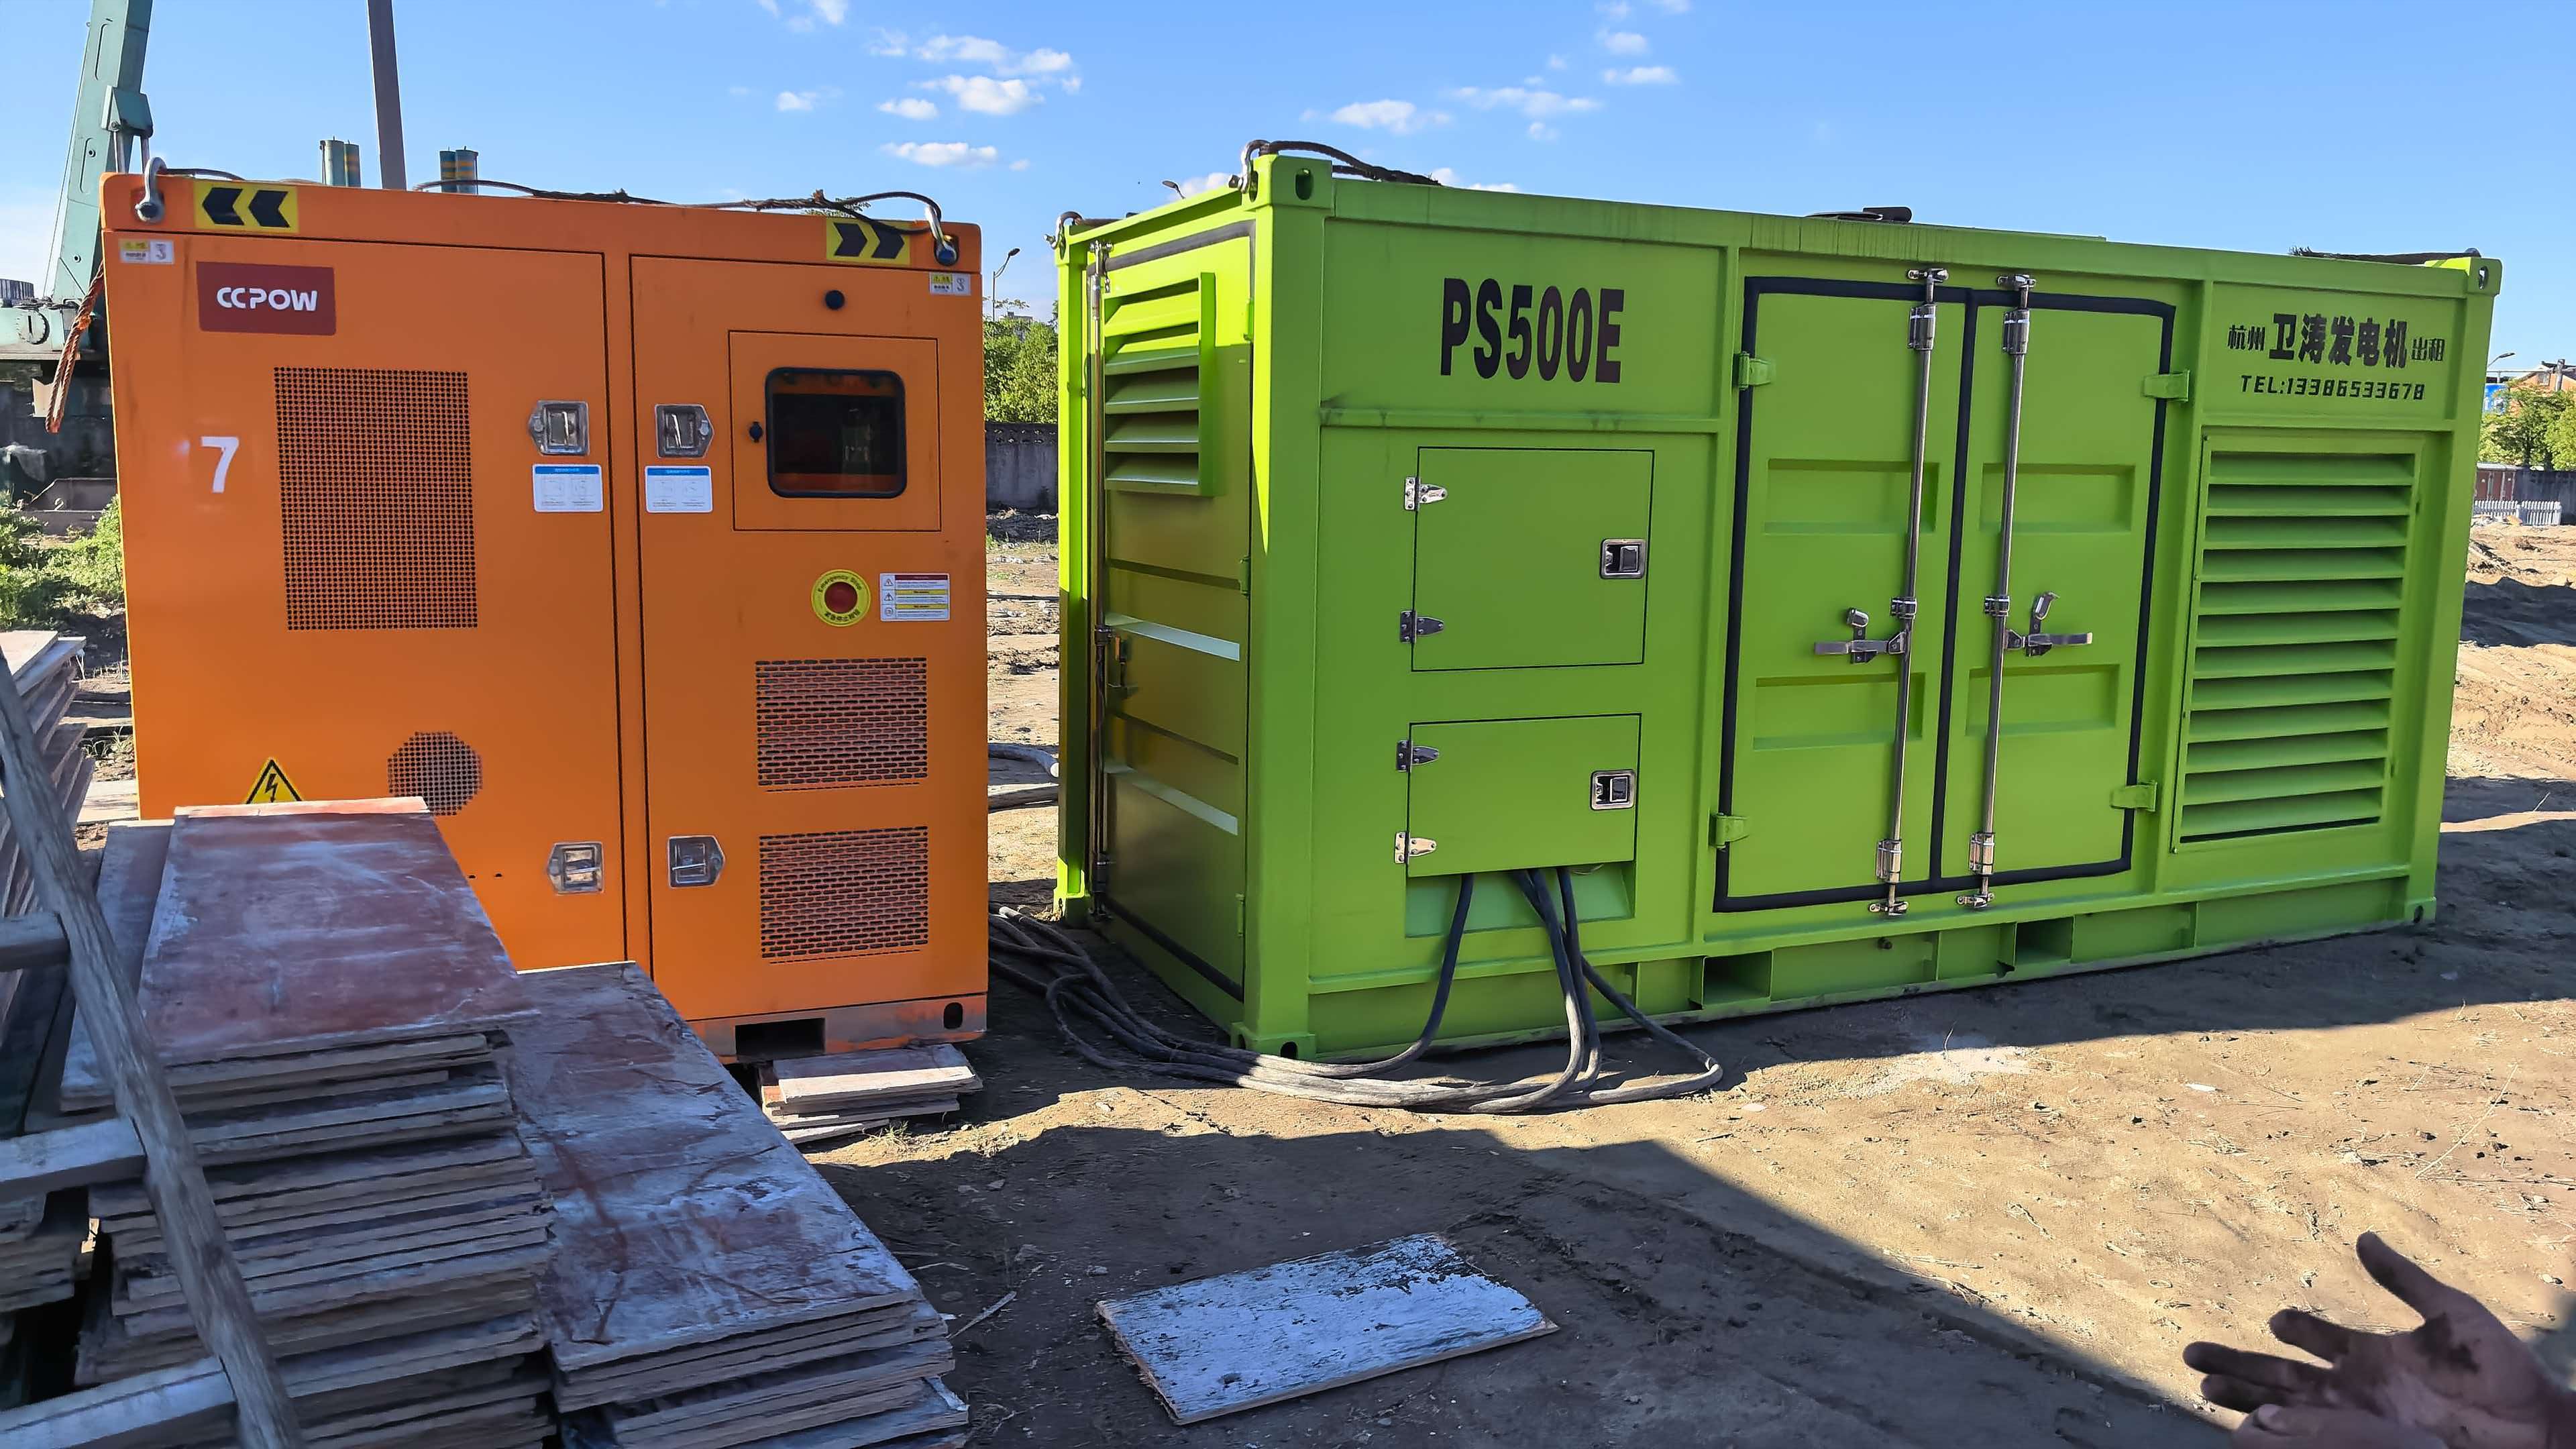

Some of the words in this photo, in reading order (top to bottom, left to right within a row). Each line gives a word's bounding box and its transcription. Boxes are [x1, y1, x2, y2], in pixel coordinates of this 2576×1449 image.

[216, 287, 317, 311] CCPOW
[1440, 277, 1625, 384] PS500E
[201, 436, 239, 494] 7
